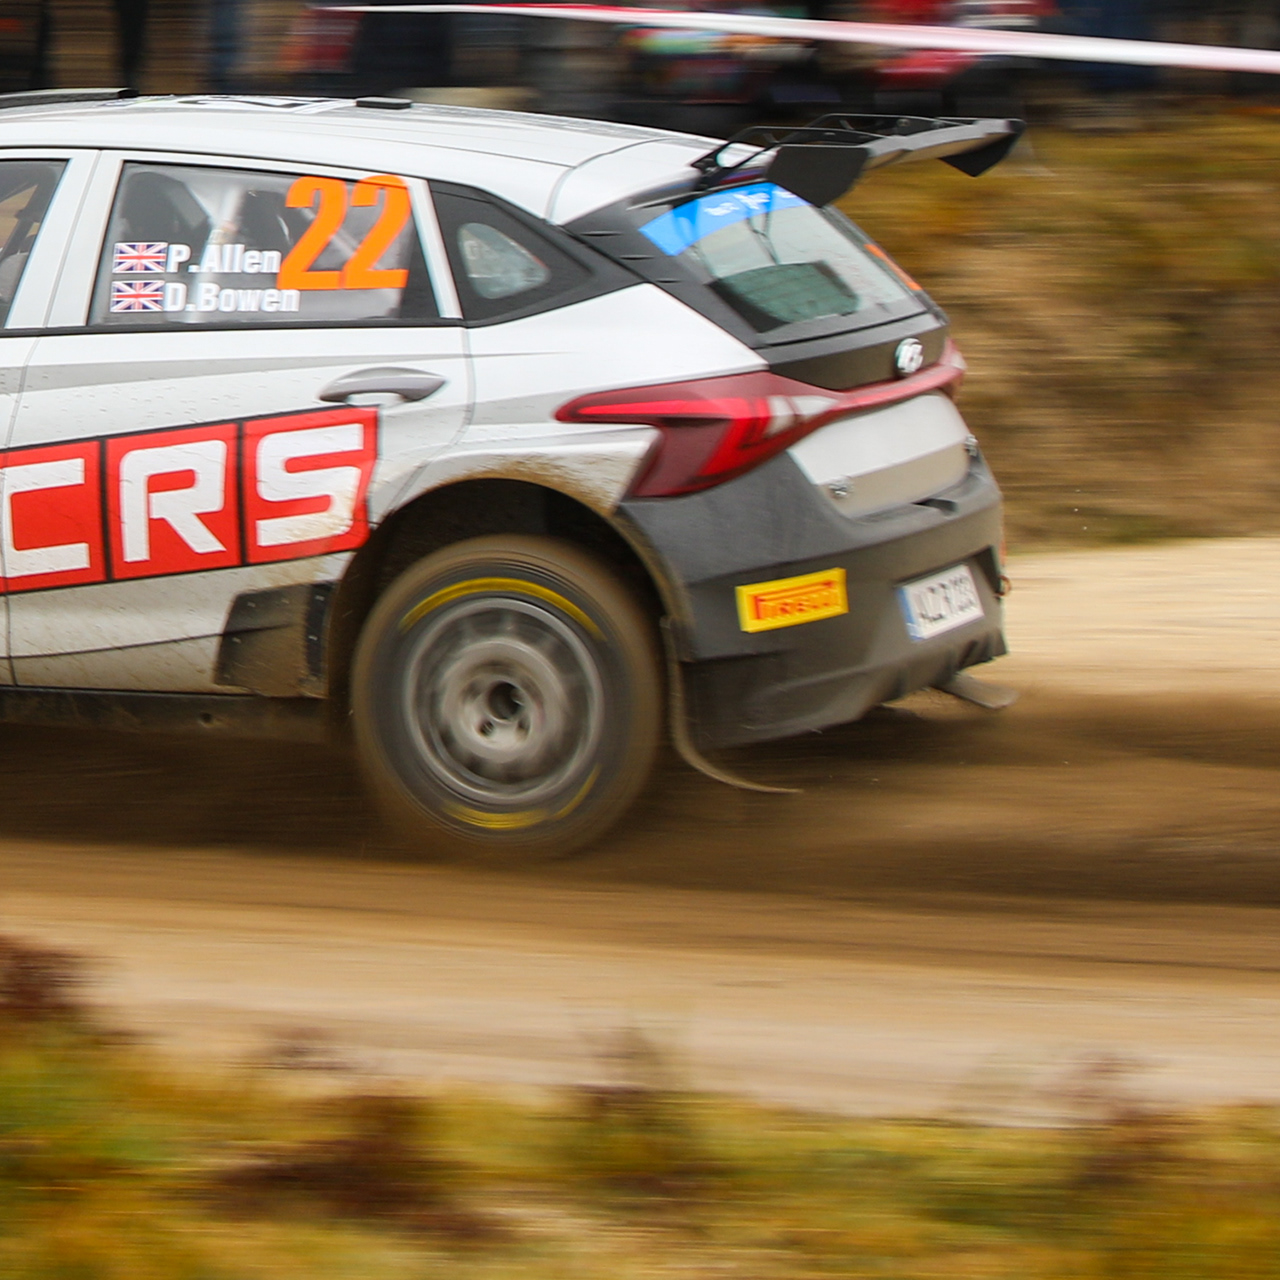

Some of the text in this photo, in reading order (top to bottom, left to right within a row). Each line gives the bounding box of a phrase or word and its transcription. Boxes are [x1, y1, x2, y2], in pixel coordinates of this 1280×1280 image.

[276, 174, 412, 290] 22
[166, 243, 282, 274] P.Allen
[162, 282, 301, 313] D.Bowen
